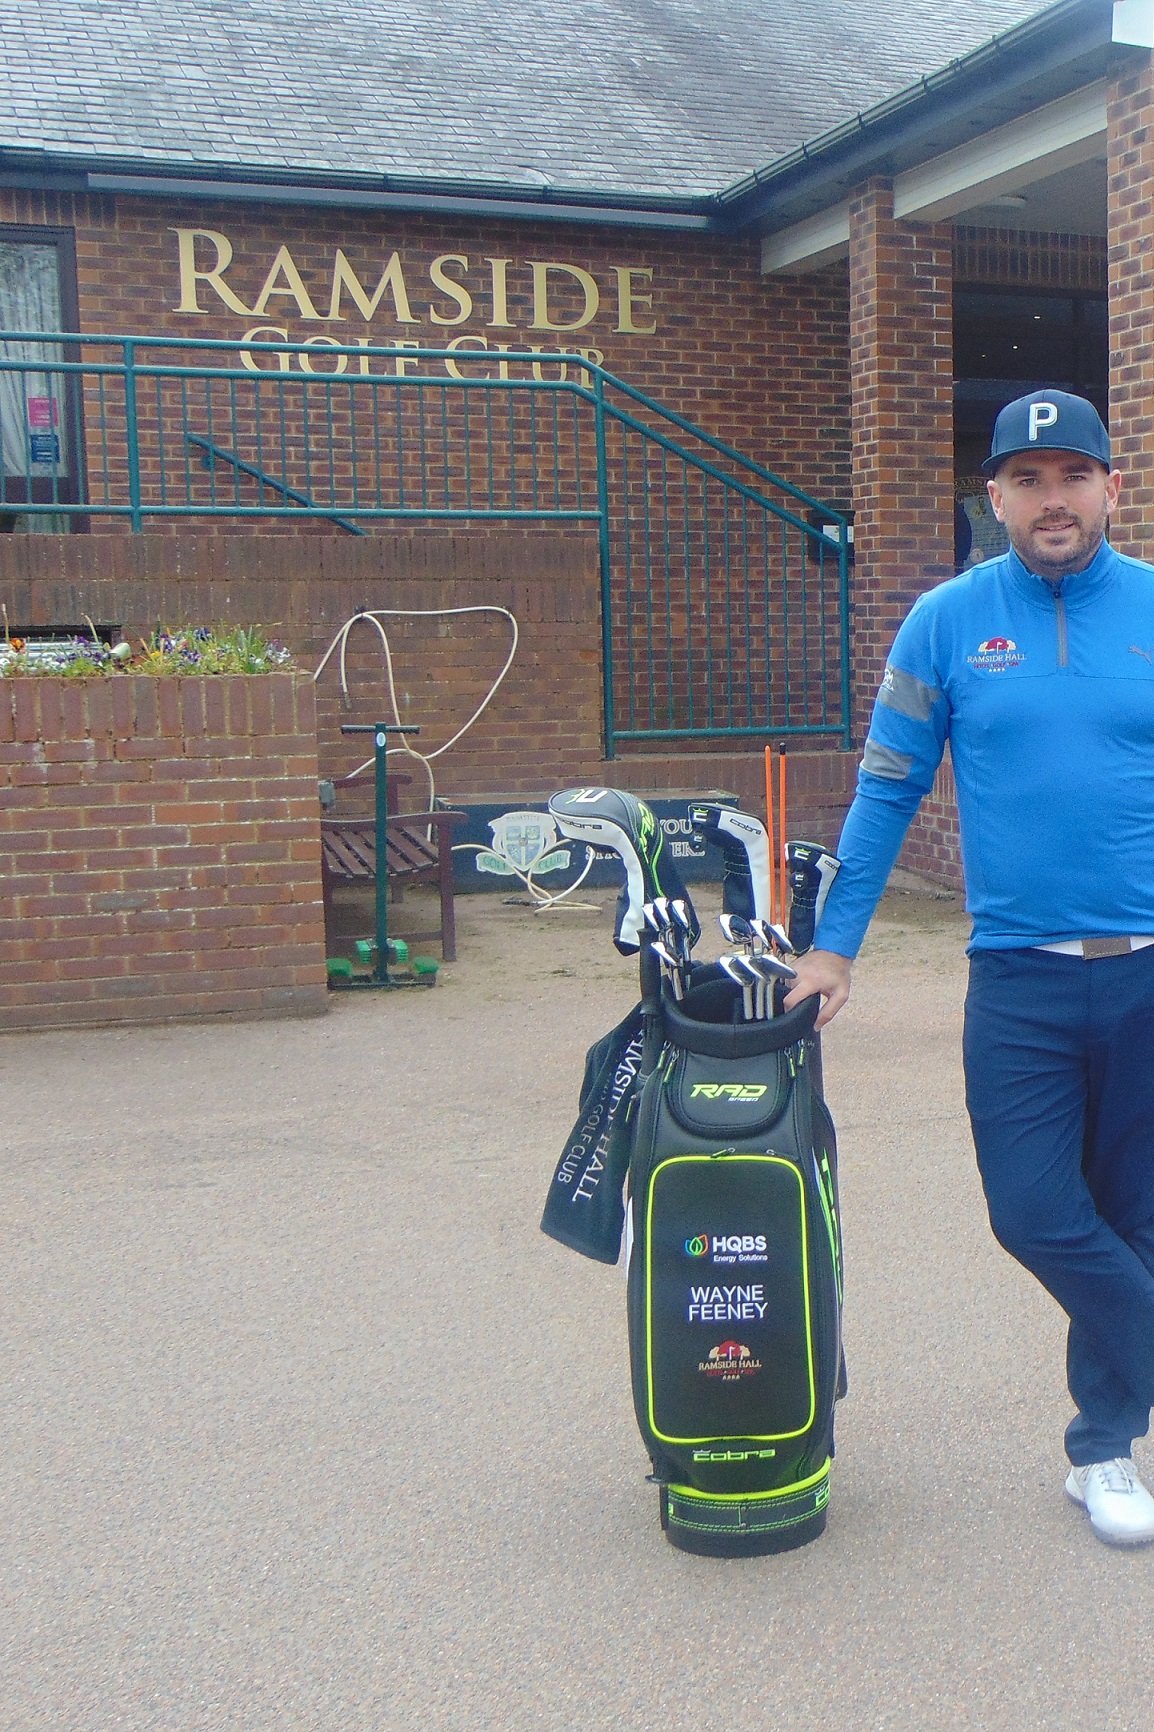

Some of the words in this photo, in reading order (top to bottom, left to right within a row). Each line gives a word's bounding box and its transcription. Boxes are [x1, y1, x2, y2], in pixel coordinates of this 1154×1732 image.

[168, 227, 657, 335] RAMSIDE
[1027, 401, 1059, 441] P
[967, 654, 1004, 663] RAMSIDE
[1005, 653, 1028, 661] HALL
[729, 817, 763, 836] cobra
[690, 1083, 768, 1099] RAD
[580, 1103, 604, 1144] GOLF
[557, 1145, 586, 1184] CLUB
[572, 1133, 611, 1202] HALL
[712, 1235, 768, 1254] HQBS
[713, 1254, 737, 1263] Energy
[738, 1253, 769, 1262] Solutions
[690, 1284, 765, 1304] WAYNE
[688, 1302, 769, 1321] FEENEY
[698, 1360, 737, 1371] RAMSIDE
[738, 1359, 763, 1368] HALL
[693, 1449, 776, 1462] cobra
